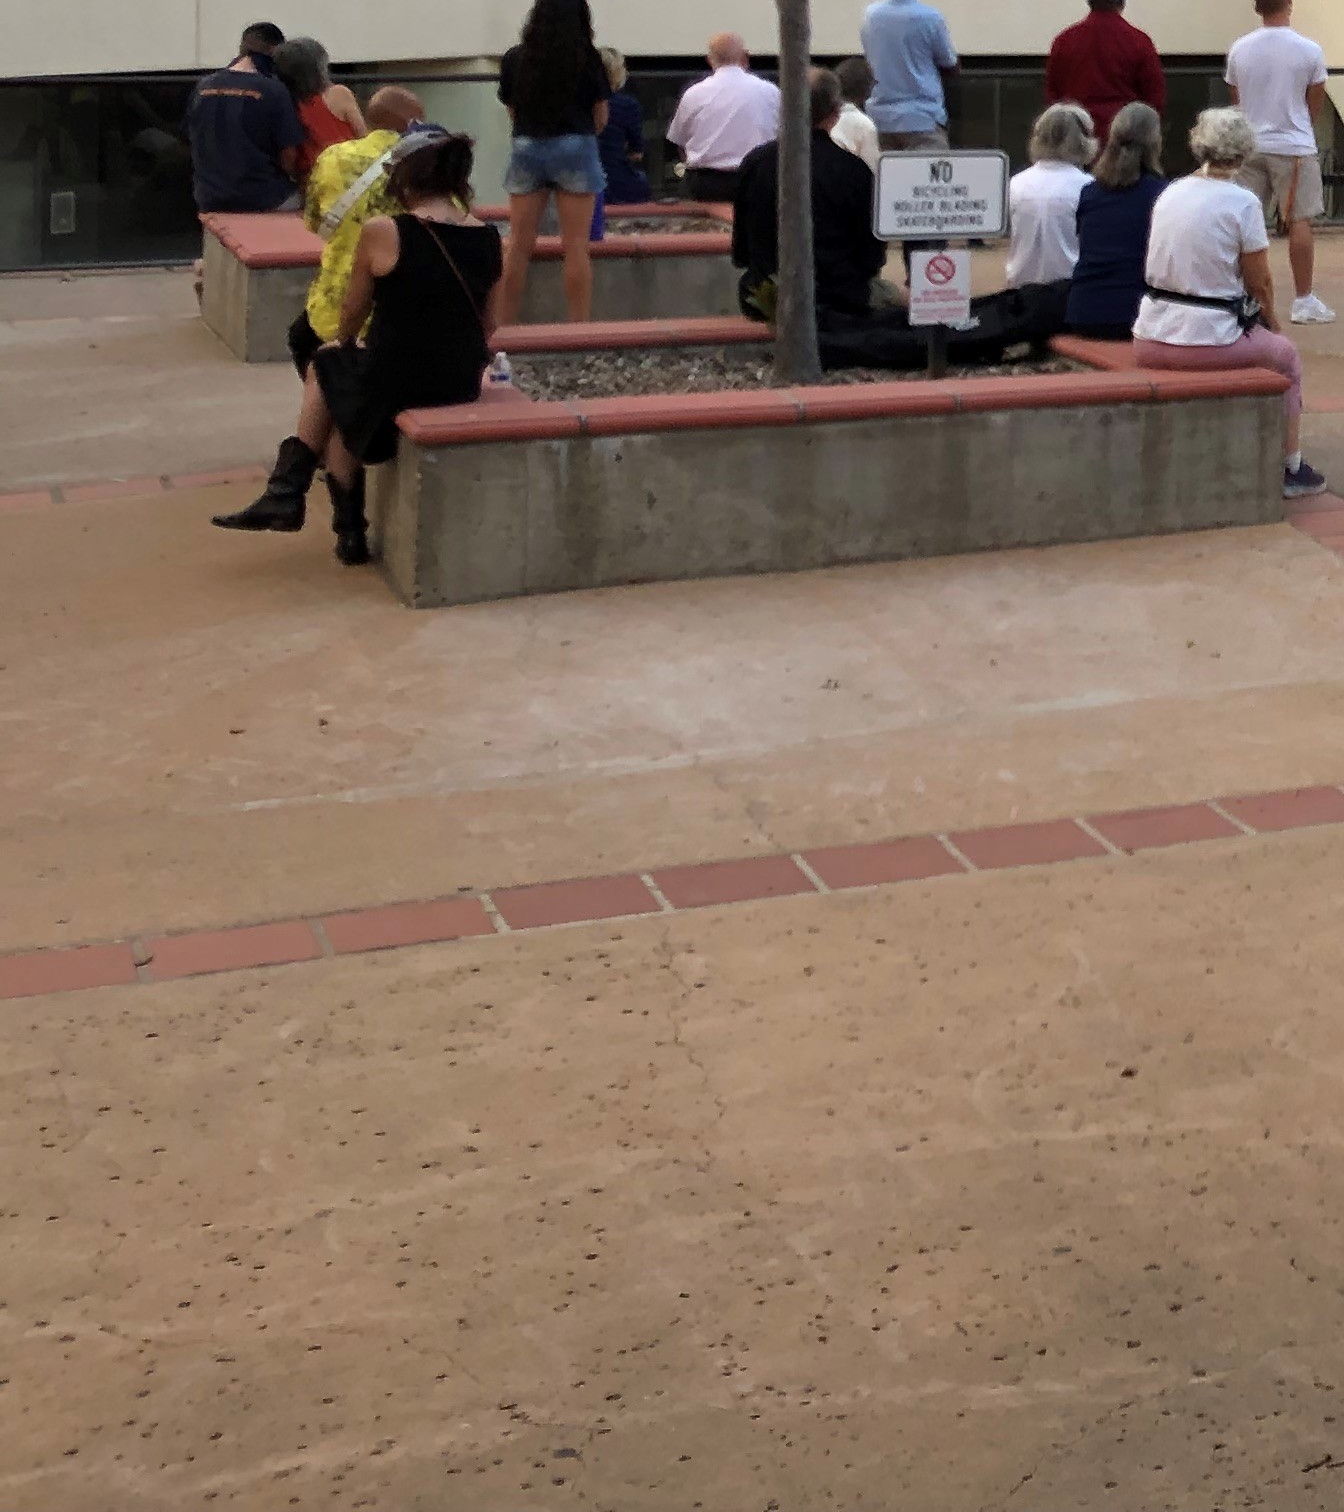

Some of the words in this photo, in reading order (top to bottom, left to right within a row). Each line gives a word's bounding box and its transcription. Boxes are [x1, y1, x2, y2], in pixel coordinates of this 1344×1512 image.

[930, 161, 953, 183] NO
[893, 199, 935, 212] ROLLER
[939, 199, 988, 212] BLADING
[896, 214, 984, 228] SKATEBOARDING
